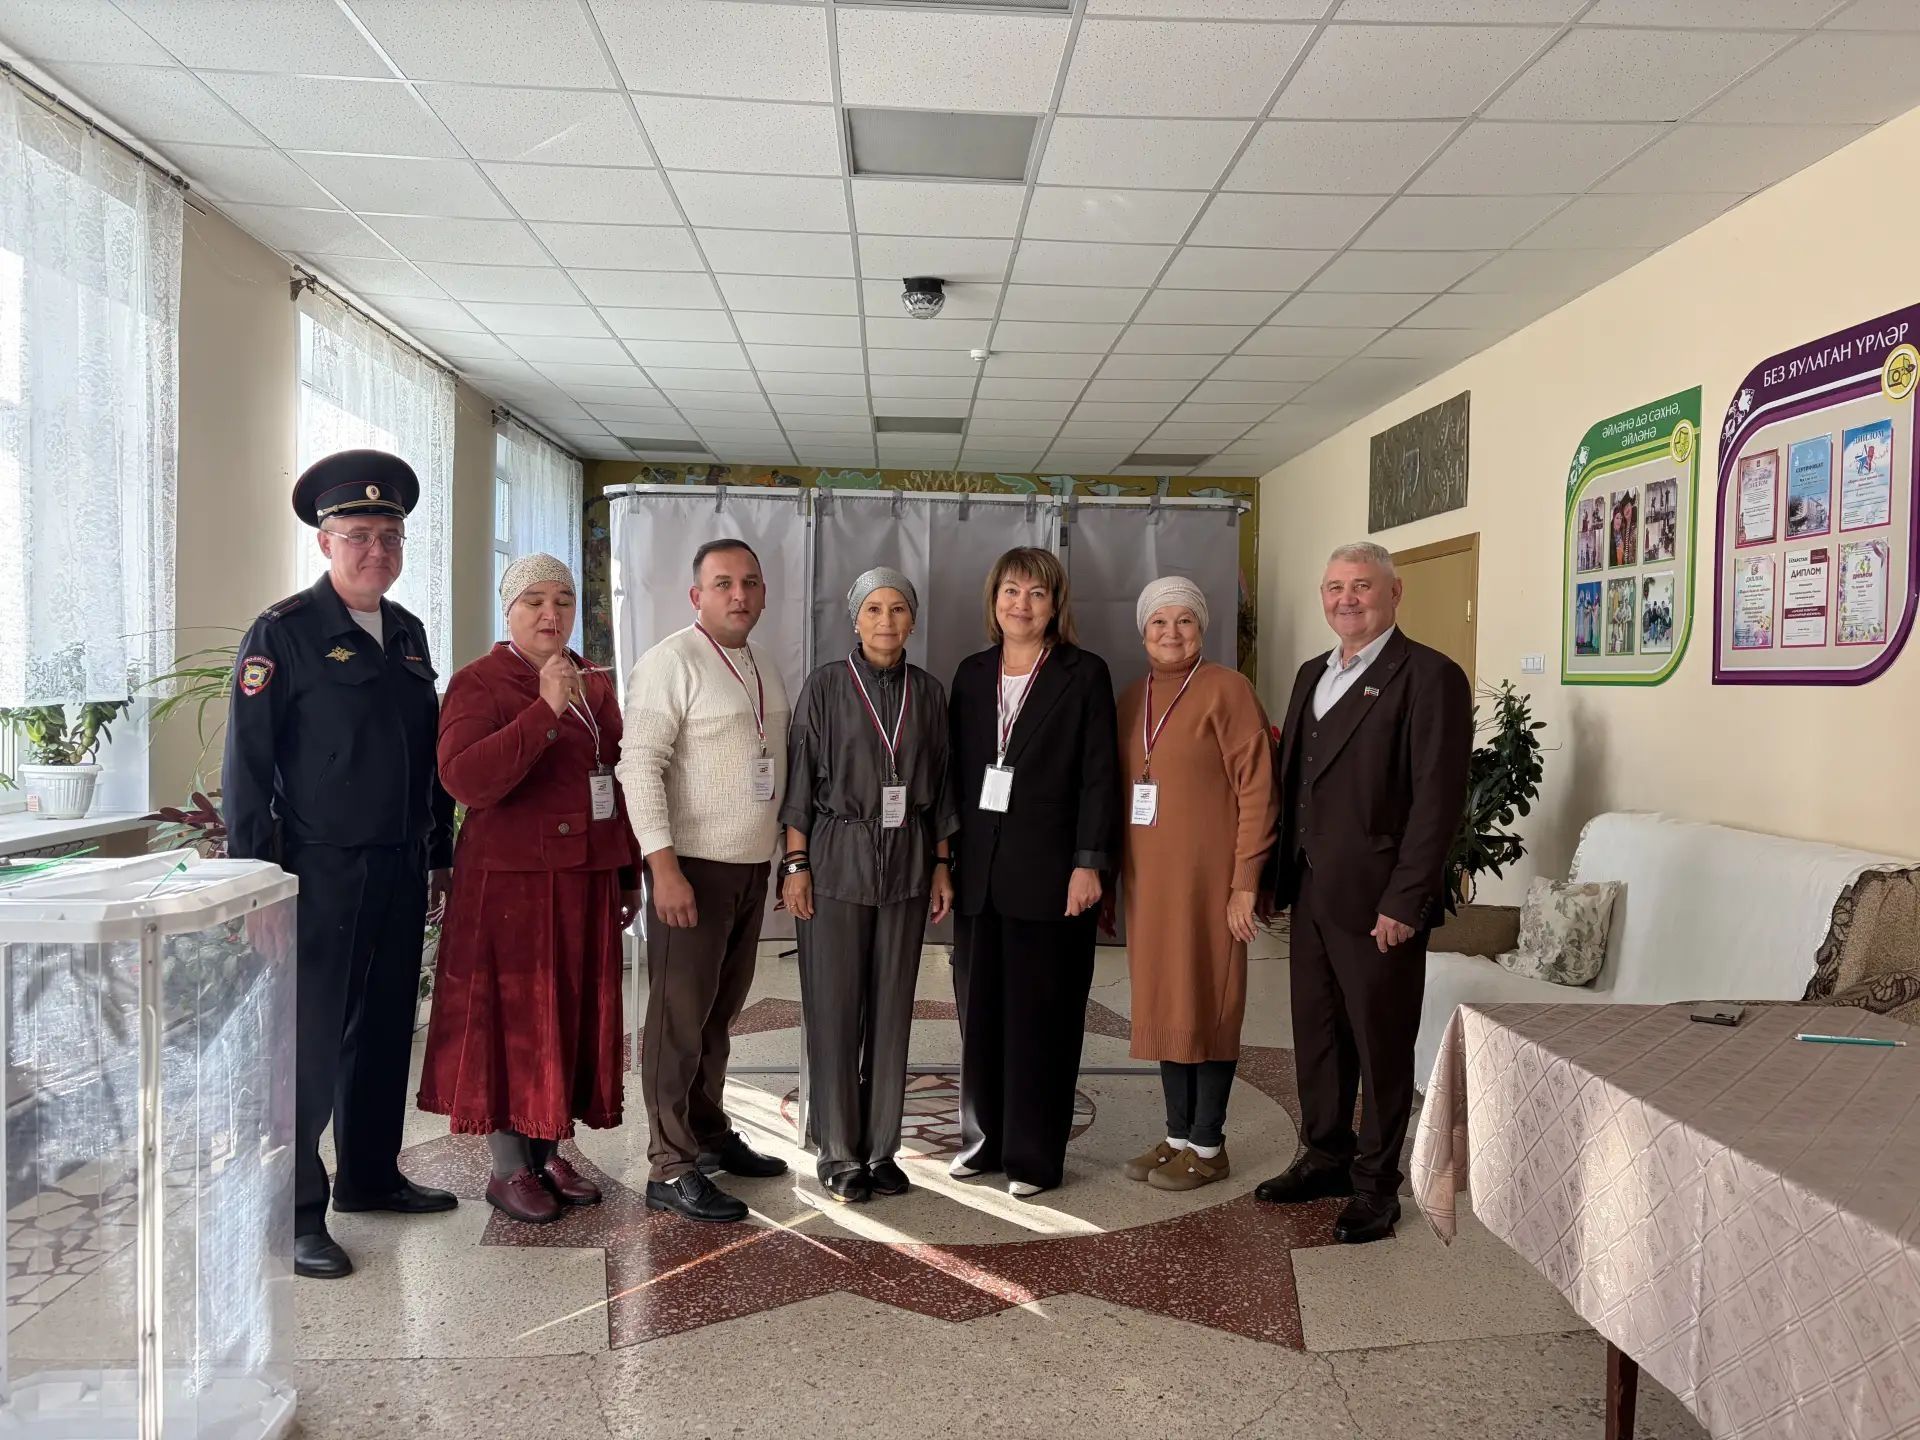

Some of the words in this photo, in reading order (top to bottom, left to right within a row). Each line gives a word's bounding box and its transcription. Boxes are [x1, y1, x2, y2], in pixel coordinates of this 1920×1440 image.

[1763, 365, 1786, 388] БЕЗ
[1788, 341, 1852, 380] ЯУЛАГАН
[1855, 322, 1909, 356] ҮРЛӘР
[1790, 567, 1822, 579] ДИПЛОМ
